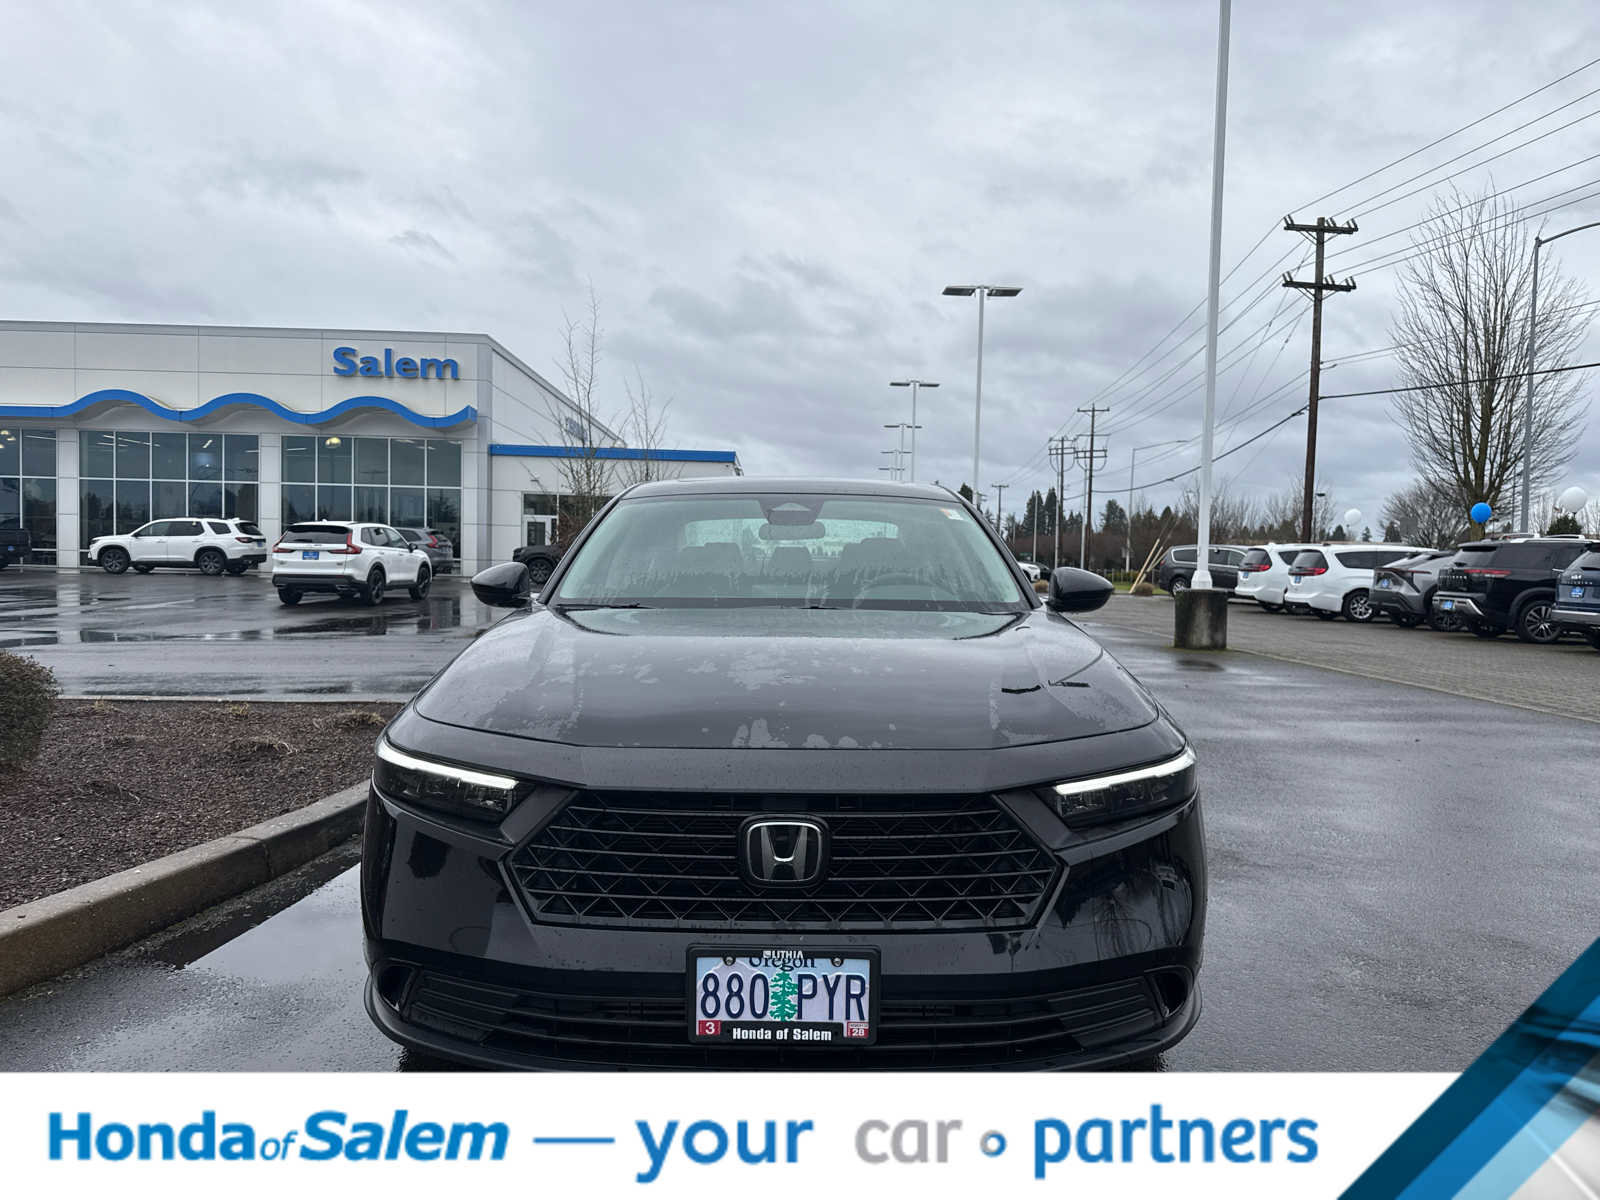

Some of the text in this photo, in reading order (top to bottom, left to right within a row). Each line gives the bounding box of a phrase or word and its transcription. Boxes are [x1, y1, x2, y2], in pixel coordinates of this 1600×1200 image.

[333, 346, 459, 380] Salem
[771, 950, 803, 959] LITHIA
[700, 973, 866, 1021] 880 PYR
[705, 1022, 715, 1035] 3
[732, 1028, 832, 1041] Honda of Salem
